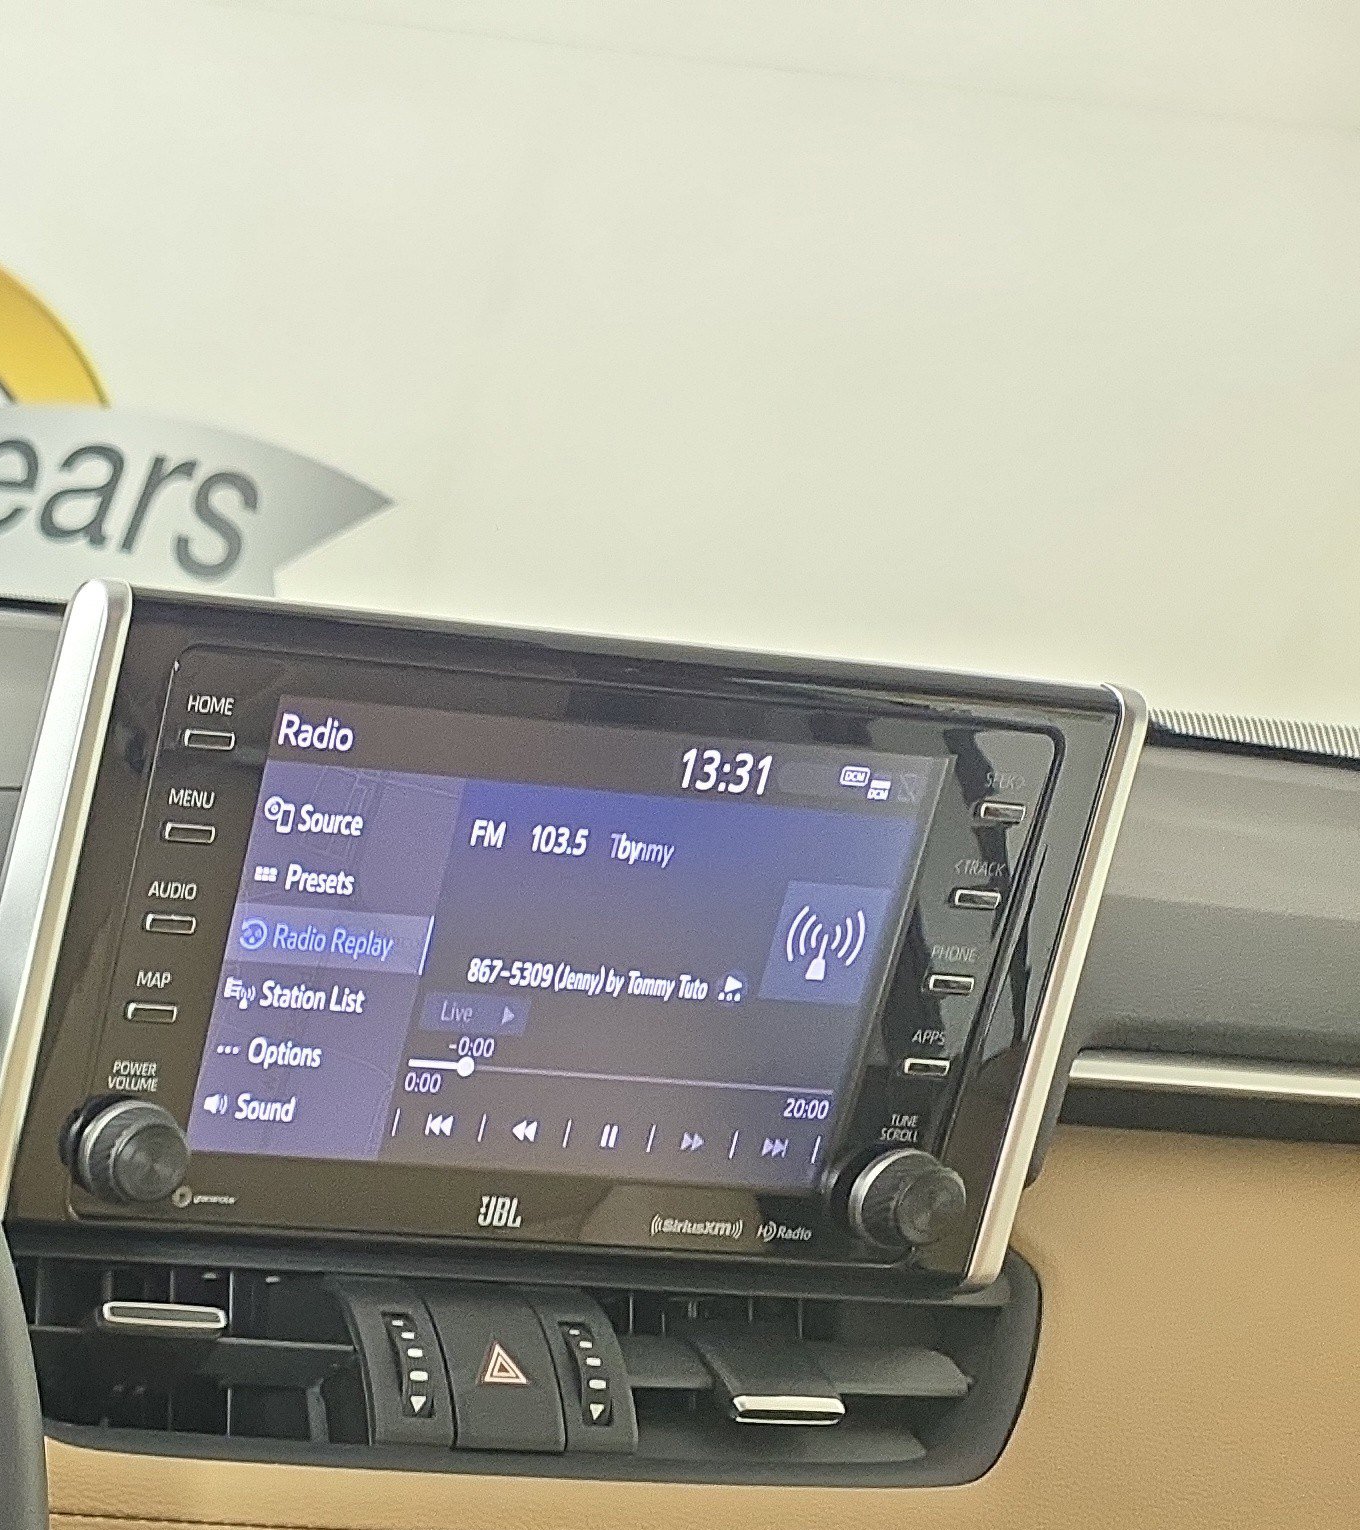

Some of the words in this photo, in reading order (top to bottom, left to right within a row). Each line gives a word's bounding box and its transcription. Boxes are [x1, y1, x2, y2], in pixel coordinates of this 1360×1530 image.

[187, 695, 234, 716] HOME
[278, 713, 354, 751] Radio
[681, 748, 773, 795] 13:31
[169, 787, 215, 809] MENU
[297, 804, 363, 837] Source
[470, 819, 506, 848] FM
[531, 825, 588, 856] 103.5
[285, 864, 354, 895] Presets
[148, 881, 197, 901] AUDIO
[273, 924, 326, 952] Radio
[331, 929, 393, 961] Replay
[931, 945, 977, 963] PHONE
[136, 970, 172, 989] MAP
[467, 957, 554, 988] 867-5309
[554, 963, 605, 995] (Jenny)
[605, 968, 625, 997] by
[628, 970, 675, 1001] Tommy
[678, 975, 708, 1000] Tuto
[260, 980, 325, 1011] Station
[330, 985, 365, 1014] List
[440, 1000, 473, 1023] Live
[448, 1037, 495, 1057] -0:00
[912, 1030, 945, 1046] APPS
[247, 1037, 322, 1069] Options
[112, 1060, 157, 1077] POWER
[107, 1076, 158, 1092] VOLUME
[404, 1071, 441, 1093] 0:00
[235, 1093, 296, 1123] Sound
[783, 1098, 829, 1119] 20:00
[891, 1113, 917, 1128] TUNE
[880, 1128, 918, 1143] SCROLL
[478, 1196, 521, 1229] JBL
[777, 1225, 812, 1241] Radio
